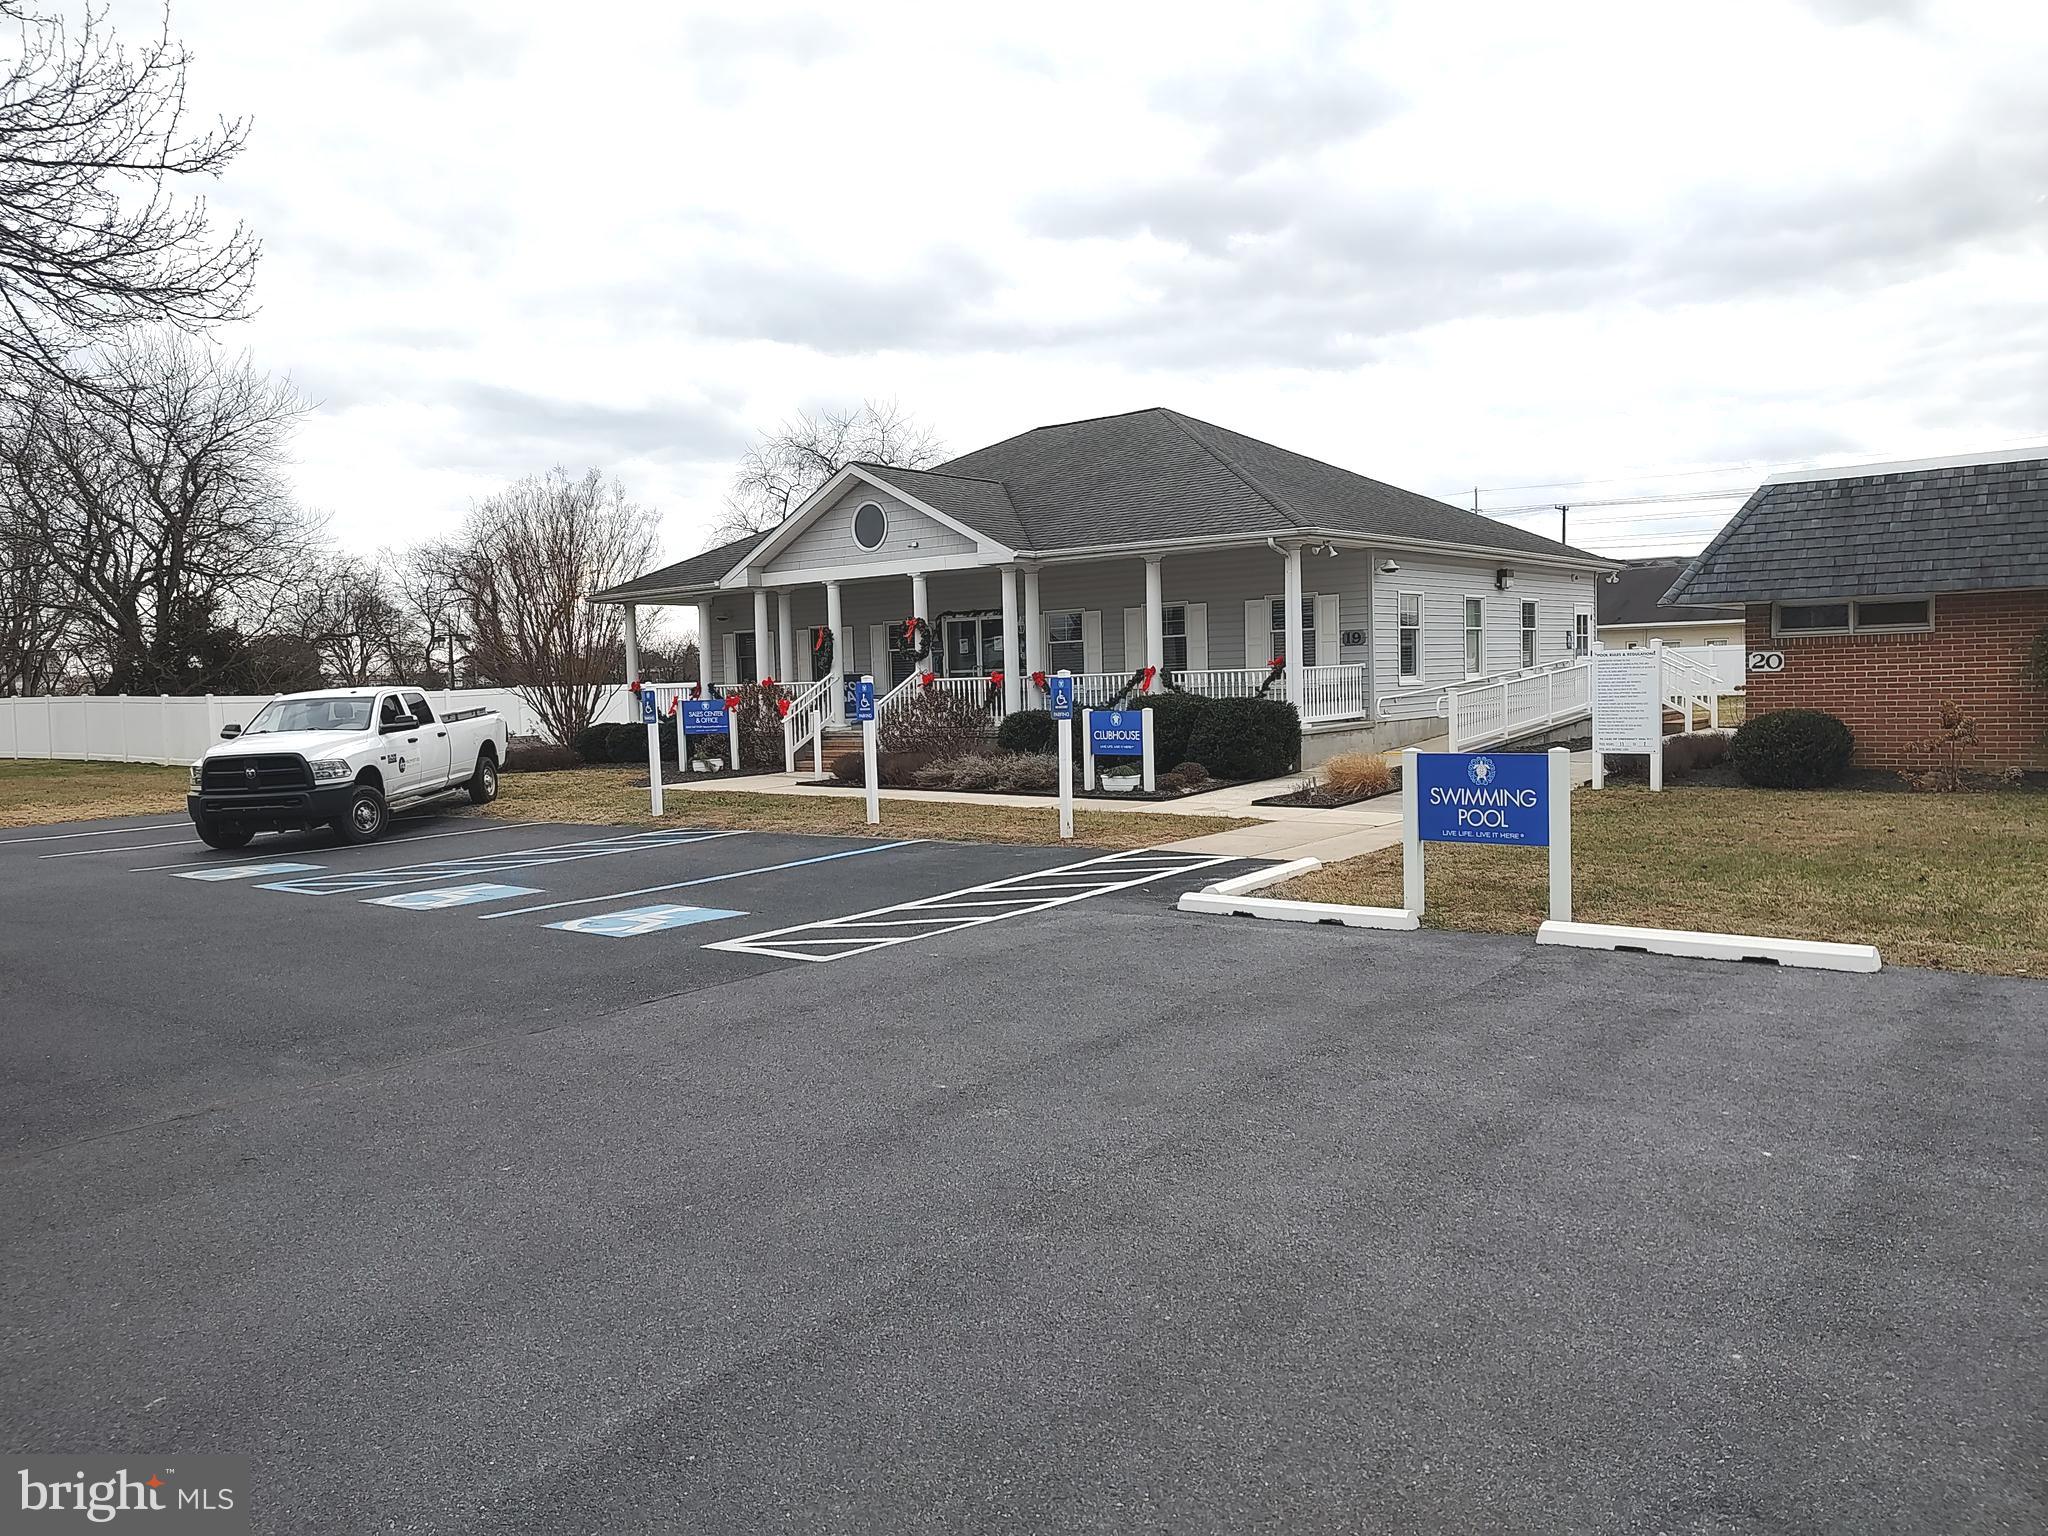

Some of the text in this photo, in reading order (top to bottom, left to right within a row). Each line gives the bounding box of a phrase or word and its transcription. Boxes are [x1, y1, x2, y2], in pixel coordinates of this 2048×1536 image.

[1346, 631, 1361, 643] 19
[1751, 653, 1783, 670] 20
[1093, 730, 1140, 740] CLUBHOUSE
[1430, 787, 1537, 807] SWIMMING
[1458, 808, 1509, 828] POOL
